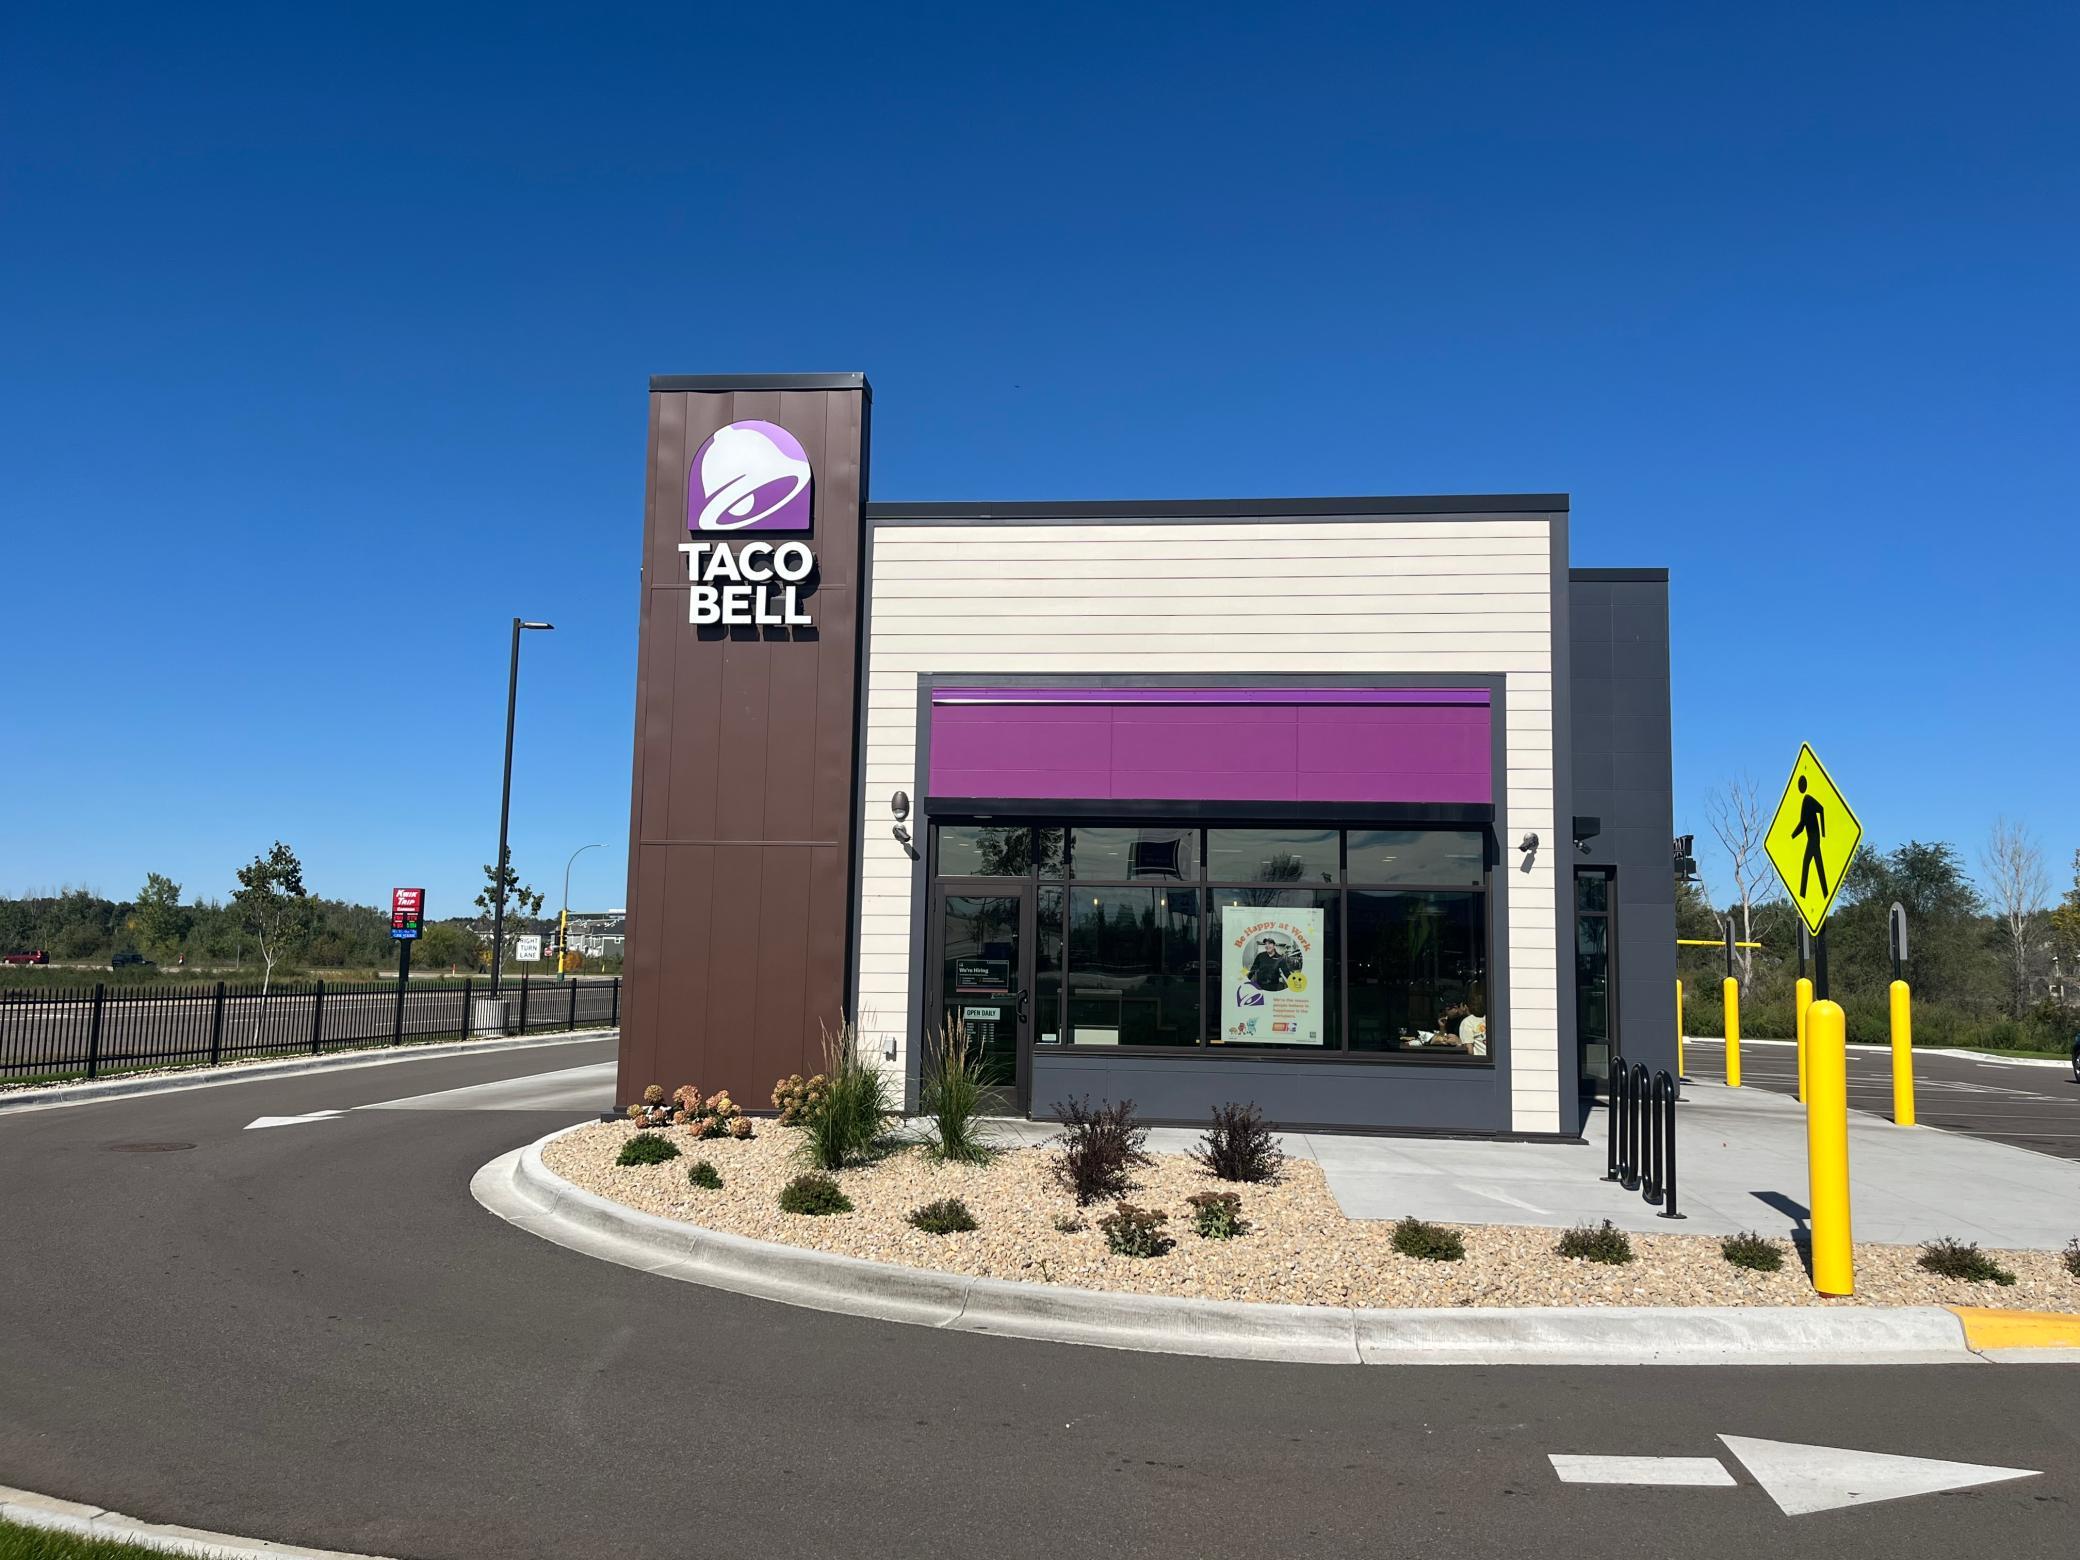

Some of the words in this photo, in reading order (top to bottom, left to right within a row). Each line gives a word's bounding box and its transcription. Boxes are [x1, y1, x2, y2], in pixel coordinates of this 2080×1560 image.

[678, 541, 813, 581] TACO
[689, 585, 812, 624] BELL
[396, 890, 418, 898] KWIK
[397, 897, 415, 905] TRIP
[1234, 936, 1246, 948] Be
[1244, 921, 1276, 936] Happy
[1279, 922, 1289, 930] at
[1291, 926, 1311, 952] Work
